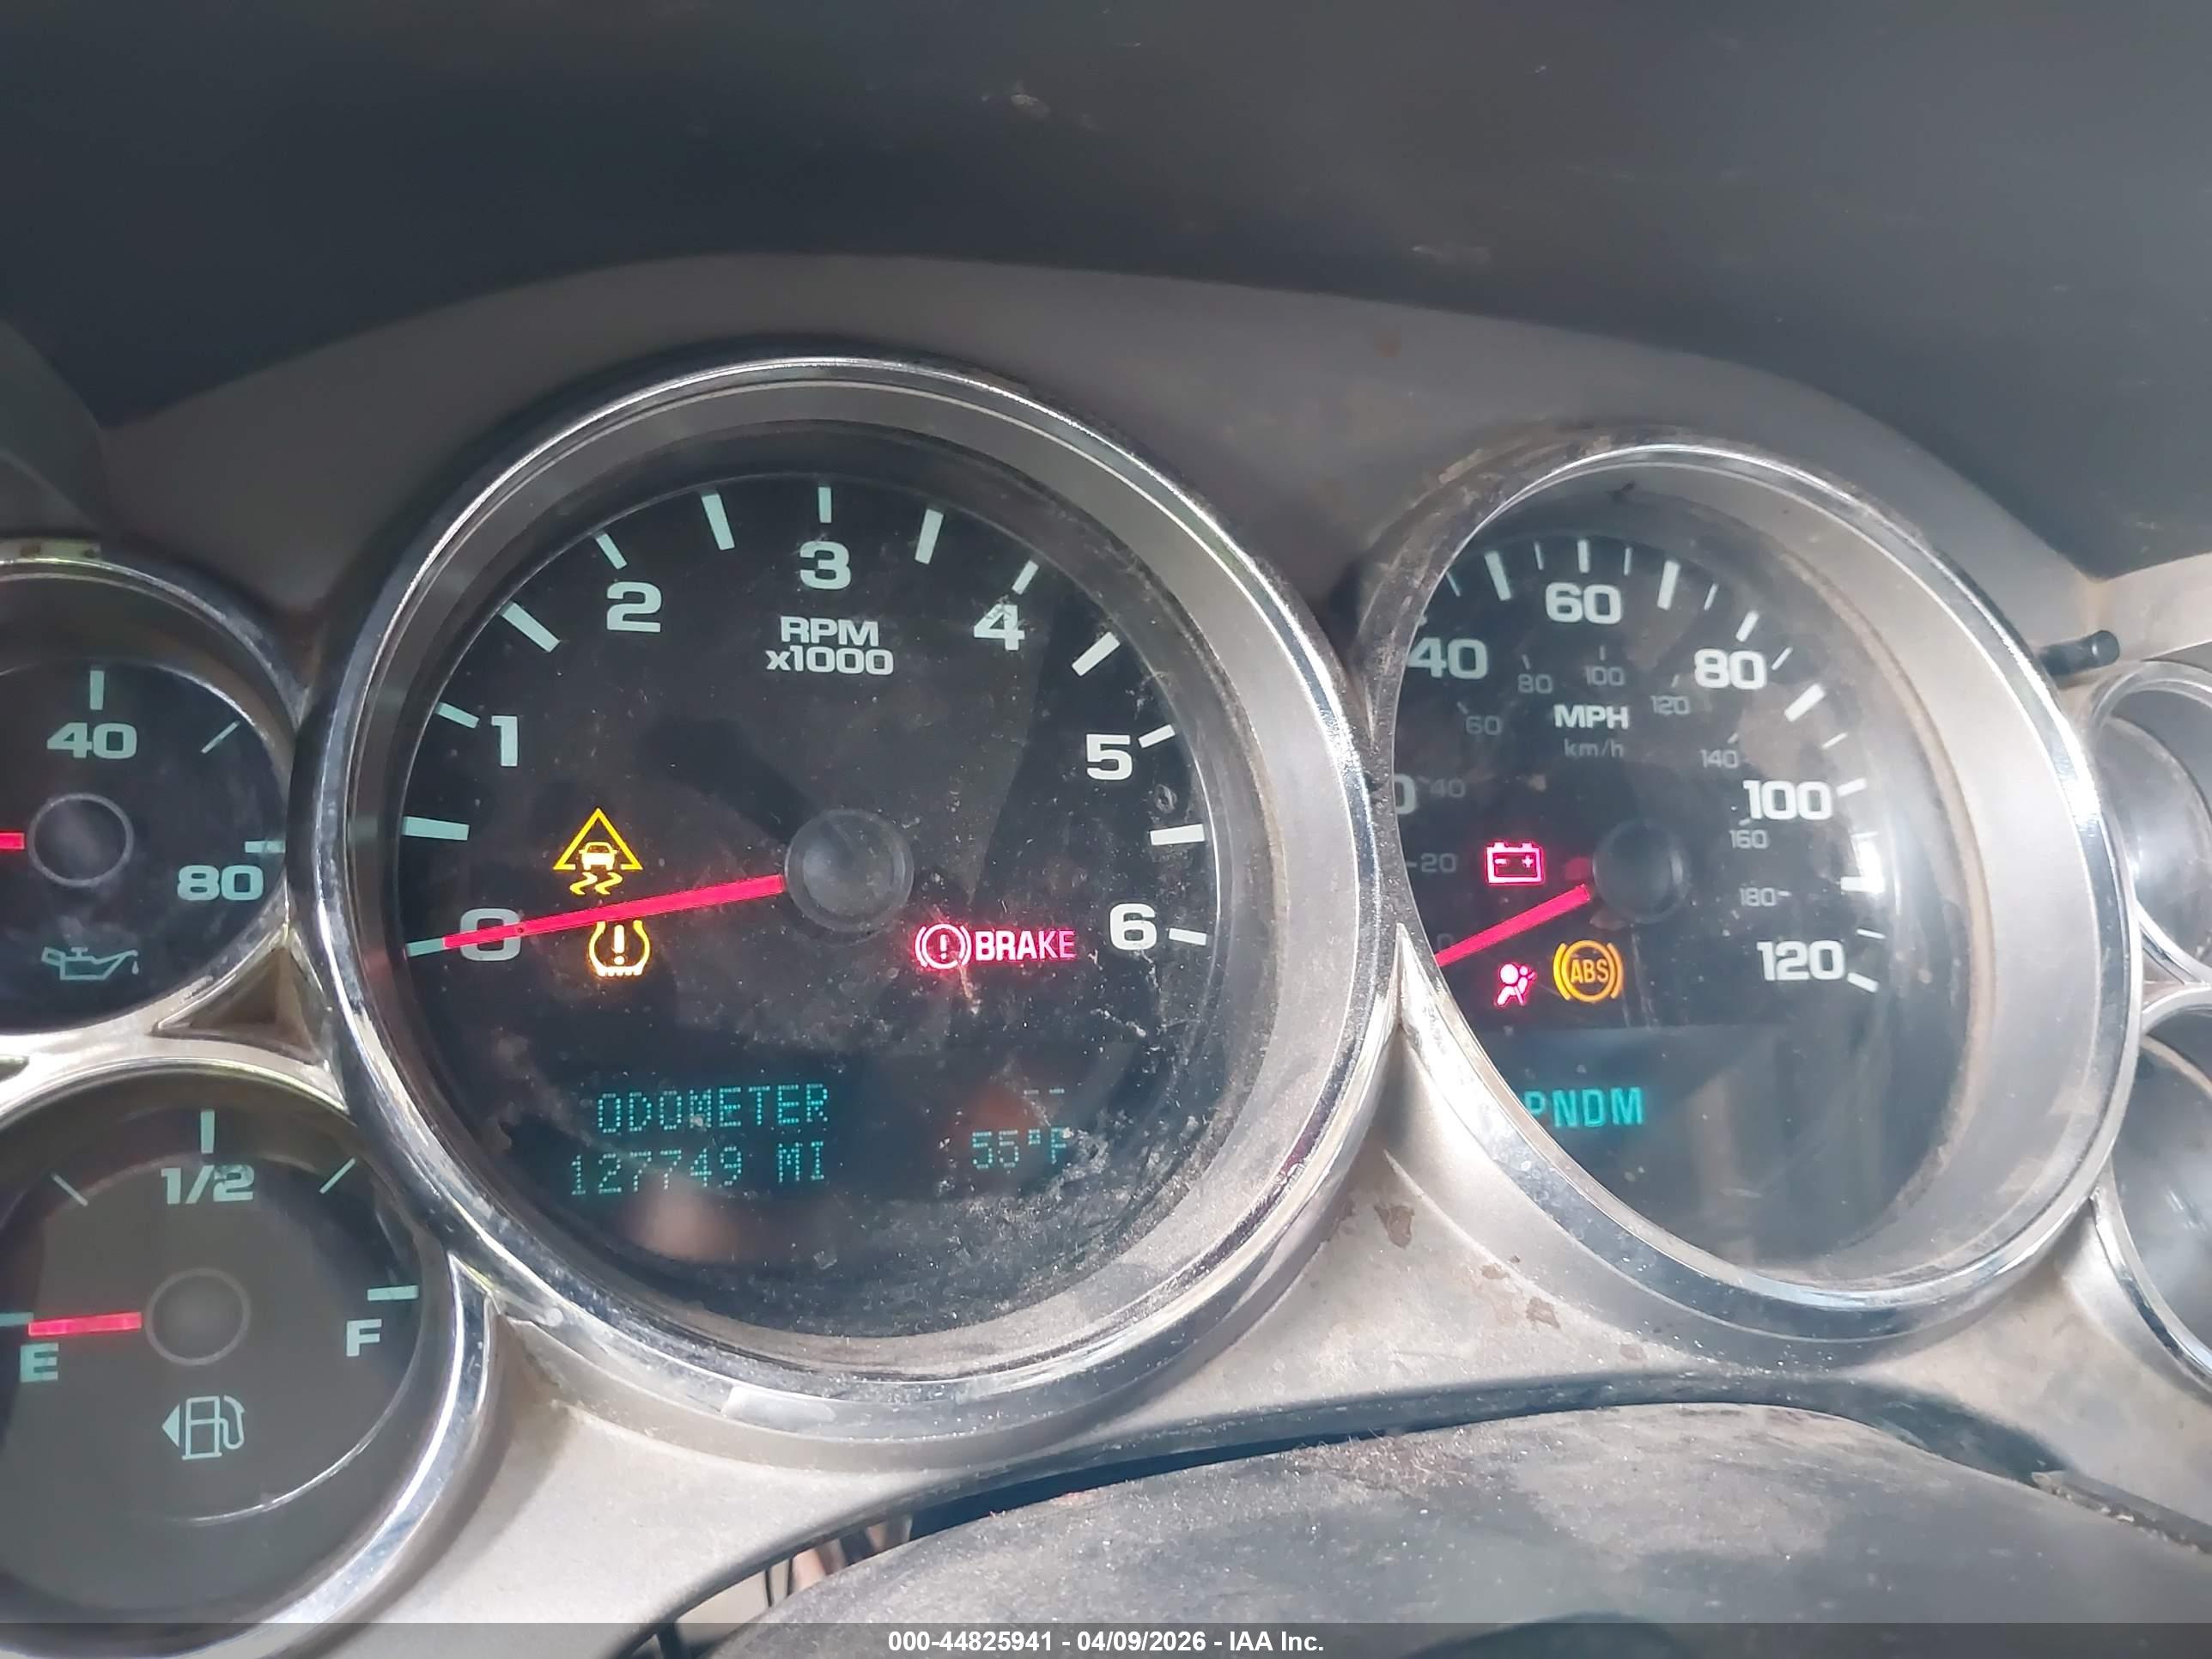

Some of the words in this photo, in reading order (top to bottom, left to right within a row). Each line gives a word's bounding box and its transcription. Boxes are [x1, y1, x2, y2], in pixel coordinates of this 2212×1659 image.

[799, 541, 851, 590] 3
[606, 581, 662, 633] 2
[1546, 583, 1621, 624] 60
[781, 617, 878, 646] RPM
[974, 604, 1025, 651] 4
[766, 647, 894, 676] x1000
[1407, 637, 1488, 679] 40
[1585, 665, 1626, 686] 100
[1694, 648, 1766, 690] 80
[1518, 674, 1553, 694] 80
[1553, 704, 1629, 730] MPH
[1650, 695, 1690, 716] 120
[46, 722, 137, 758] 40
[491, 715, 519, 767] 1
[1466, 715, 1503, 736] 60
[1085, 733, 1133, 781] 5
[1564, 738, 1625, 757] km/h
[1700, 748, 1739, 769] 140
[1430, 778, 1466, 798] 40
[1743, 779, 1833, 820] 100
[1729, 830, 1769, 850] 160
[1420, 853, 1457, 873] 20
[177, 865, 264, 901] 80
[1740, 886, 1776, 908] 180
[459, 908, 521, 962] 0
[1109, 903, 1158, 950] 6
[975, 929, 1076, 962] BRAKE
[1757, 940, 1845, 981] 120
[1570, 959, 1609, 983] ABS
[597, 1082, 830, 1134] ODOMETER
[161, 1164, 255, 1205] 1/2
[570, 1146, 743, 1196] 127749
[775, 1139, 825, 1184] MI
[345, 1319, 382, 1357] F
[20, 1342, 58, 1382] E
